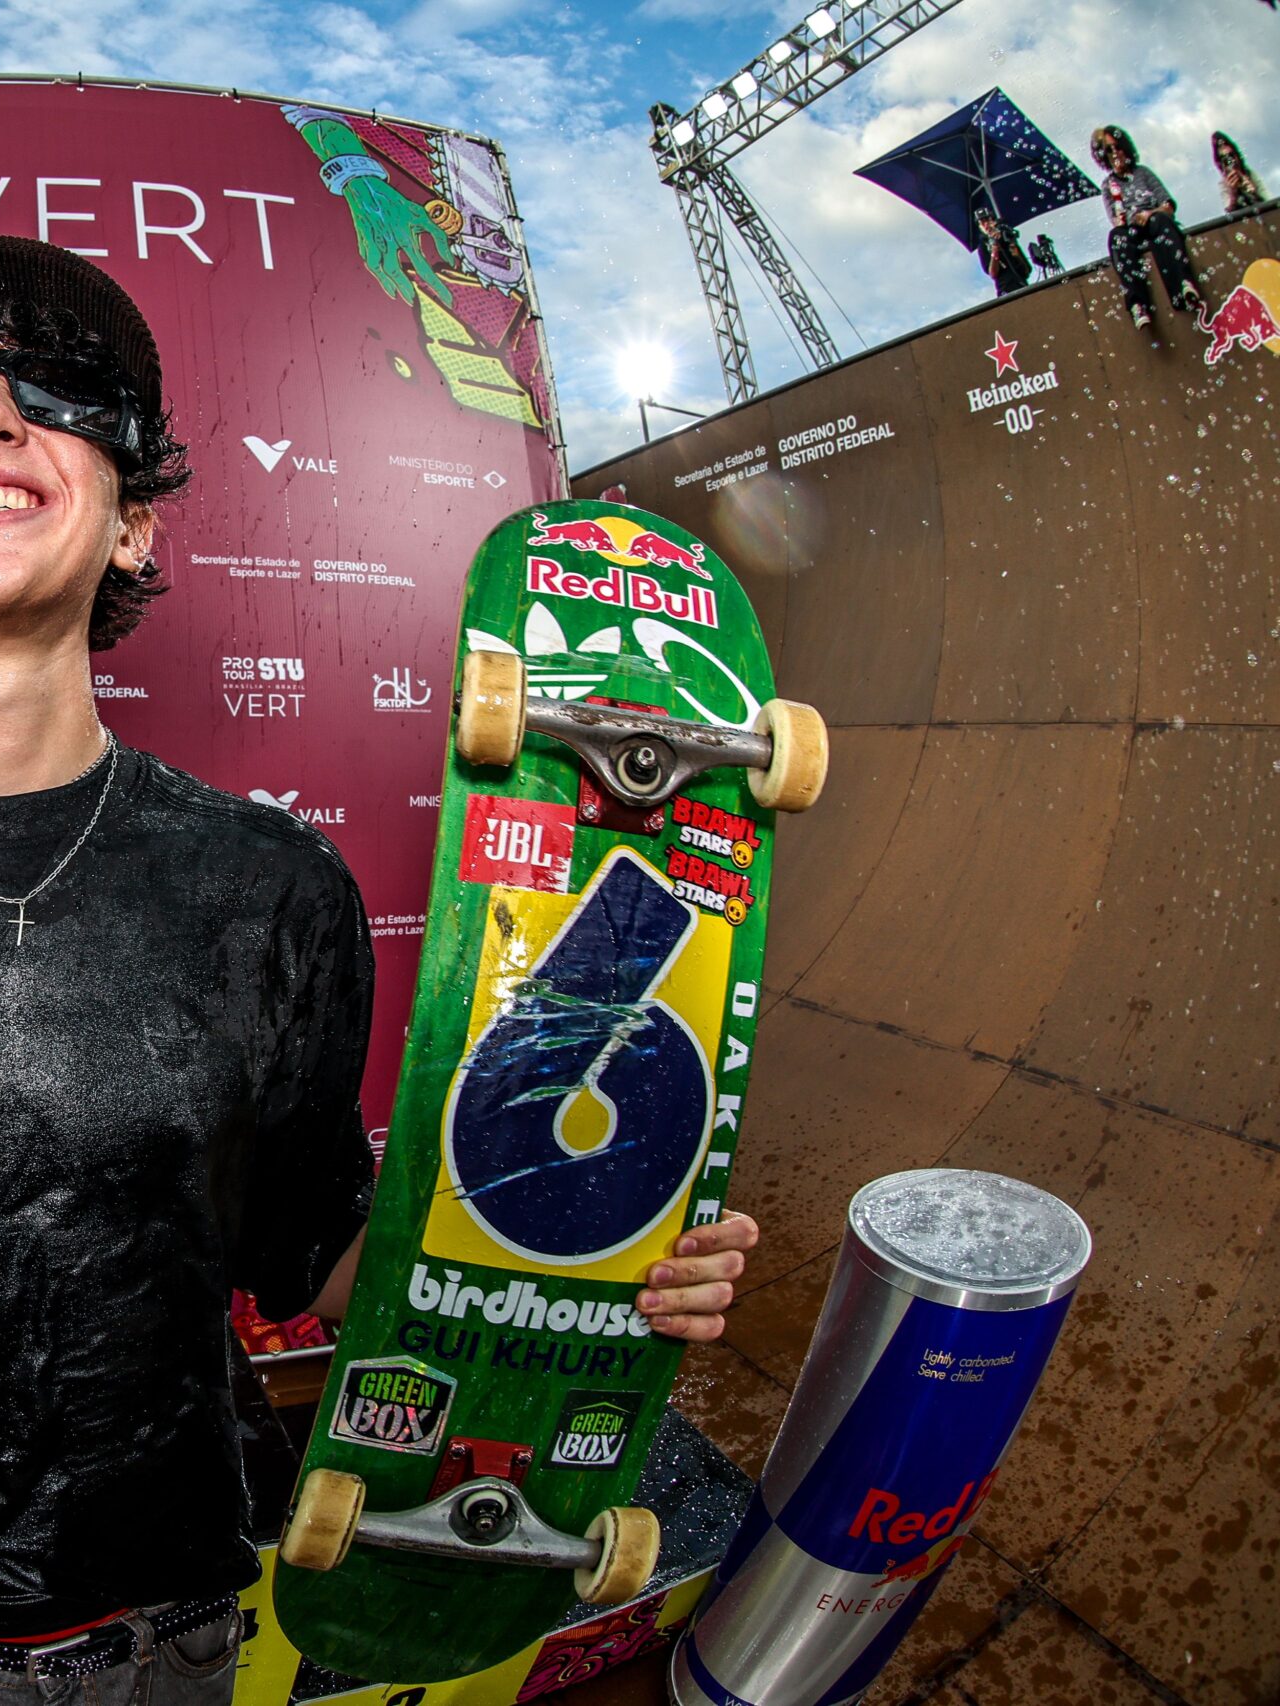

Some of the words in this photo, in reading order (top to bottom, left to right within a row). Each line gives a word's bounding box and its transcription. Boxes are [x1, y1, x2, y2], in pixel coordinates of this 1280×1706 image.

[322, 161, 344, 180] STU
[966, 367, 1059, 412] Heineken
[778, 422, 836, 454] GOVERNO
[837, 415, 857, 433] DO
[780, 441, 835, 470] DISTRITO
[836, 422, 895, 453] FEDERAL
[292, 457, 338, 474] VALE
[389, 455, 455, 472] MINISTÉRIO
[456, 464, 473, 475] DO
[674, 464, 713, 488] Secretaria
[713, 460, 724, 473] de
[724, 450, 750, 470] Estado
[751, 444, 767, 461] de
[424, 473, 475, 489] ESPORTE
[705, 471, 737, 493] Esporte
[737, 470, 745, 481] e
[745, 461, 769, 479] Lazer
[191, 554, 239, 566] Secretaria
[241, 556, 253, 566] de
[255, 557, 287, 567] Estado
[288, 558, 300, 568] de
[314, 560, 368, 573] GOVERNO
[371, 563, 387, 573] DO
[230, 568, 266, 579] Esporte
[276, 569, 301, 579] Lazer
[314, 571, 365, 583] DISTRITO
[368, 575, 416, 587] FEDERAL
[528, 556, 622, 606] Red
[627, 571, 718, 628] Bull
[222, 657, 254, 670] PRO
[257, 657, 305, 681] STU
[95, 674, 114, 685] DO
[222, 670, 255, 681] TOUR
[92, 687, 149, 698] FEDERAL
[223, 694, 306, 717] VERT
[410, 796, 441, 808] MINIS
[299, 808, 345, 824] VALE
[672, 796, 761, 849] BRAWL
[484, 819, 552, 868] JBL
[679, 825, 734, 857] STARS
[667, 850, 756, 905] BRAWL
[673, 880, 727, 912] STARS
[374, 916, 386, 925] de
[387, 914, 416, 924] Estado
[370, 927, 396, 938] sporte
[405, 926, 425, 935] Laze
[693, 982, 757, 1226] OAKLE
[408, 1262, 653, 1338] birdhouse
[398, 1320, 481, 1363] GUI
[491, 1336, 646, 1378] KHURY
[923, 1348, 956, 1369] Lightly
[918, 1363, 946, 1380] Serve
[359, 1372, 438, 1408] GREEN
[348, 1397, 433, 1441] BOX
[571, 1413, 624, 1434] GREEN
[561, 1433, 619, 1461] BOX
[847, 1481, 977, 1545] Red
[816, 1592, 906, 1614] ENERG
